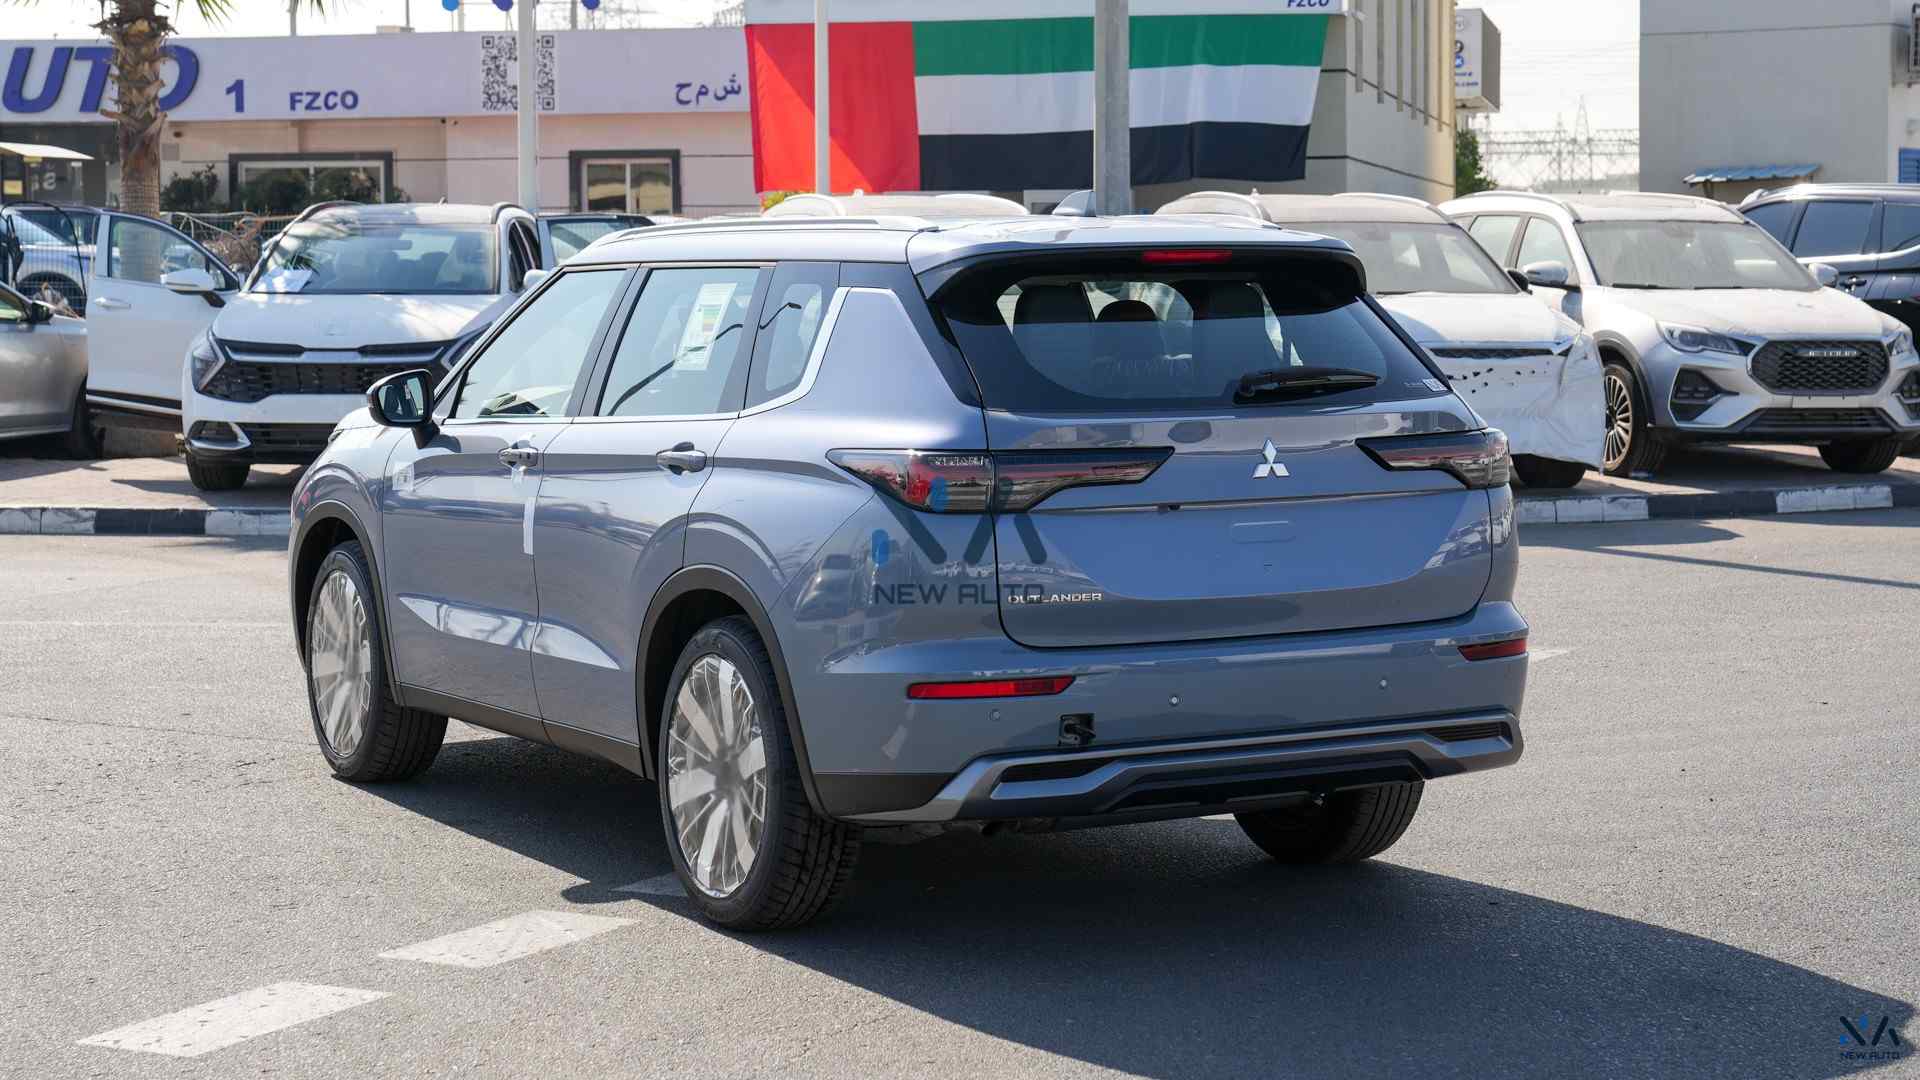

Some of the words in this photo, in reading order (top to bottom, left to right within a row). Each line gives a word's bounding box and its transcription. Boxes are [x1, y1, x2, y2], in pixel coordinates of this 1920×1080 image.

[225, 79, 245, 113] 1
[289, 90, 359, 112] FZCO
[1007, 592, 1103, 604] OUTLANDER
